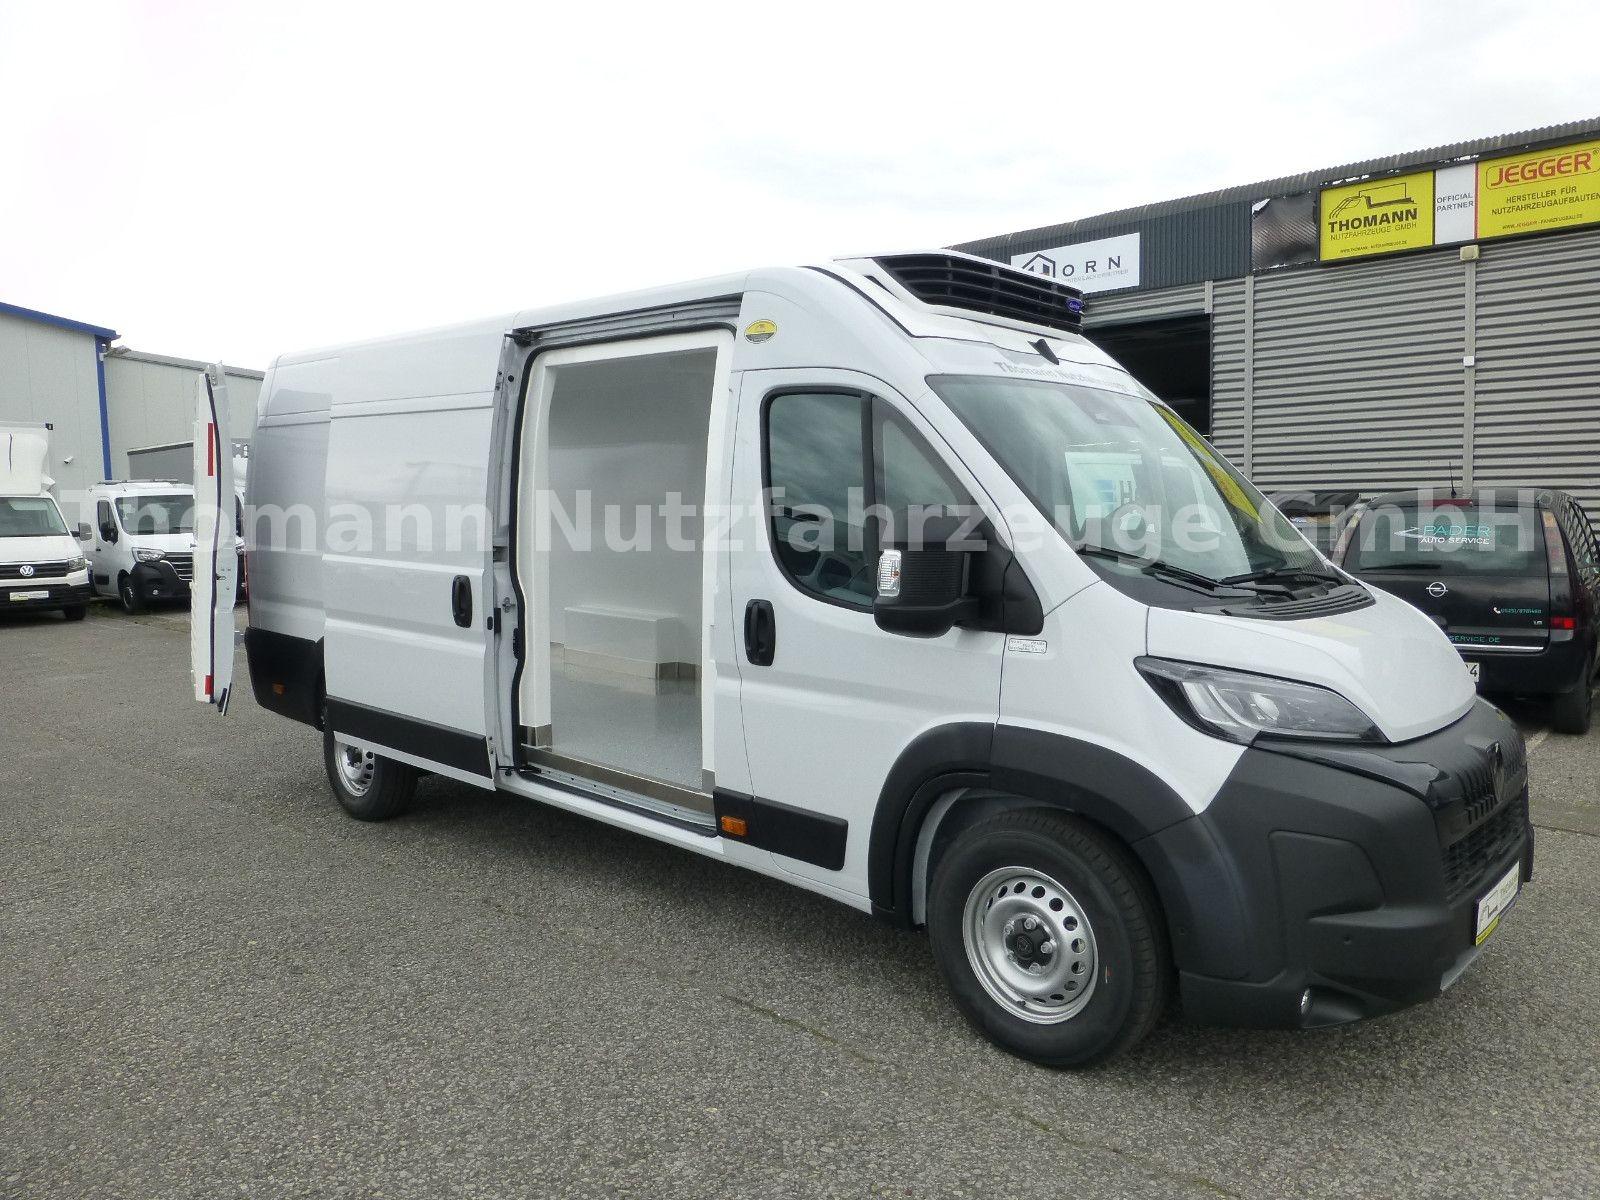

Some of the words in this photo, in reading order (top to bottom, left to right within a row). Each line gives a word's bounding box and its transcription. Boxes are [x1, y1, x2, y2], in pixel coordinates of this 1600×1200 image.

[1491, 152, 1592, 187] JEGGER
[1436, 191, 1473, 204] OFFICIAL
[1491, 192, 1600, 216] NUTZFAHRZEUGAUFBAUTEN
[1506, 189, 1557, 204] HERSTELLER
[1560, 185, 1578, 195] FÜR
[1436, 201, 1474, 212] PARTNER
[1328, 208, 1418, 233] THOMANN
[1330, 225, 1392, 241] NUTZFAHRZEUGE
[1394, 222, 1417, 231] GMBH
[1420, 536, 1445, 544] AUTO
[1448, 536, 1490, 545] SERVICE
[1423, 525, 1491, 537] PADER
